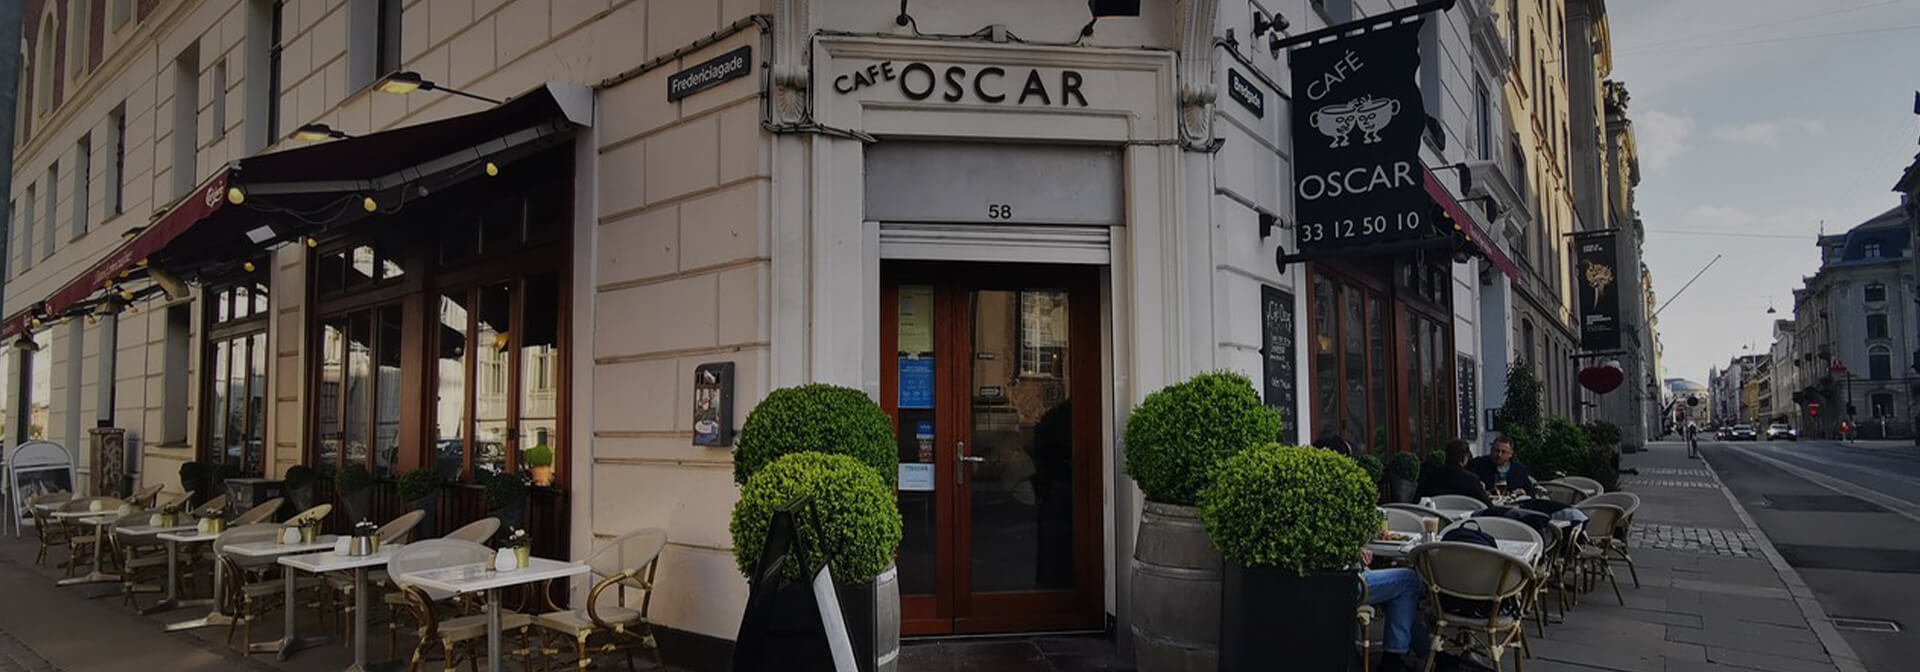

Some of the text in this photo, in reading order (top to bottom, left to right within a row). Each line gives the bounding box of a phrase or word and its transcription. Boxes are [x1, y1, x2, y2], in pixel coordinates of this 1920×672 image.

[672, 55, 743, 94] Fredericiagade
[899, 62, 1088, 107] OSCAR
[1307, 49, 1364, 101] CAFÉ
[1299, 160, 1416, 201] OSCAR
[989, 204, 1011, 219] 58
[1302, 211, 1420, 243] 33 12 50 10
